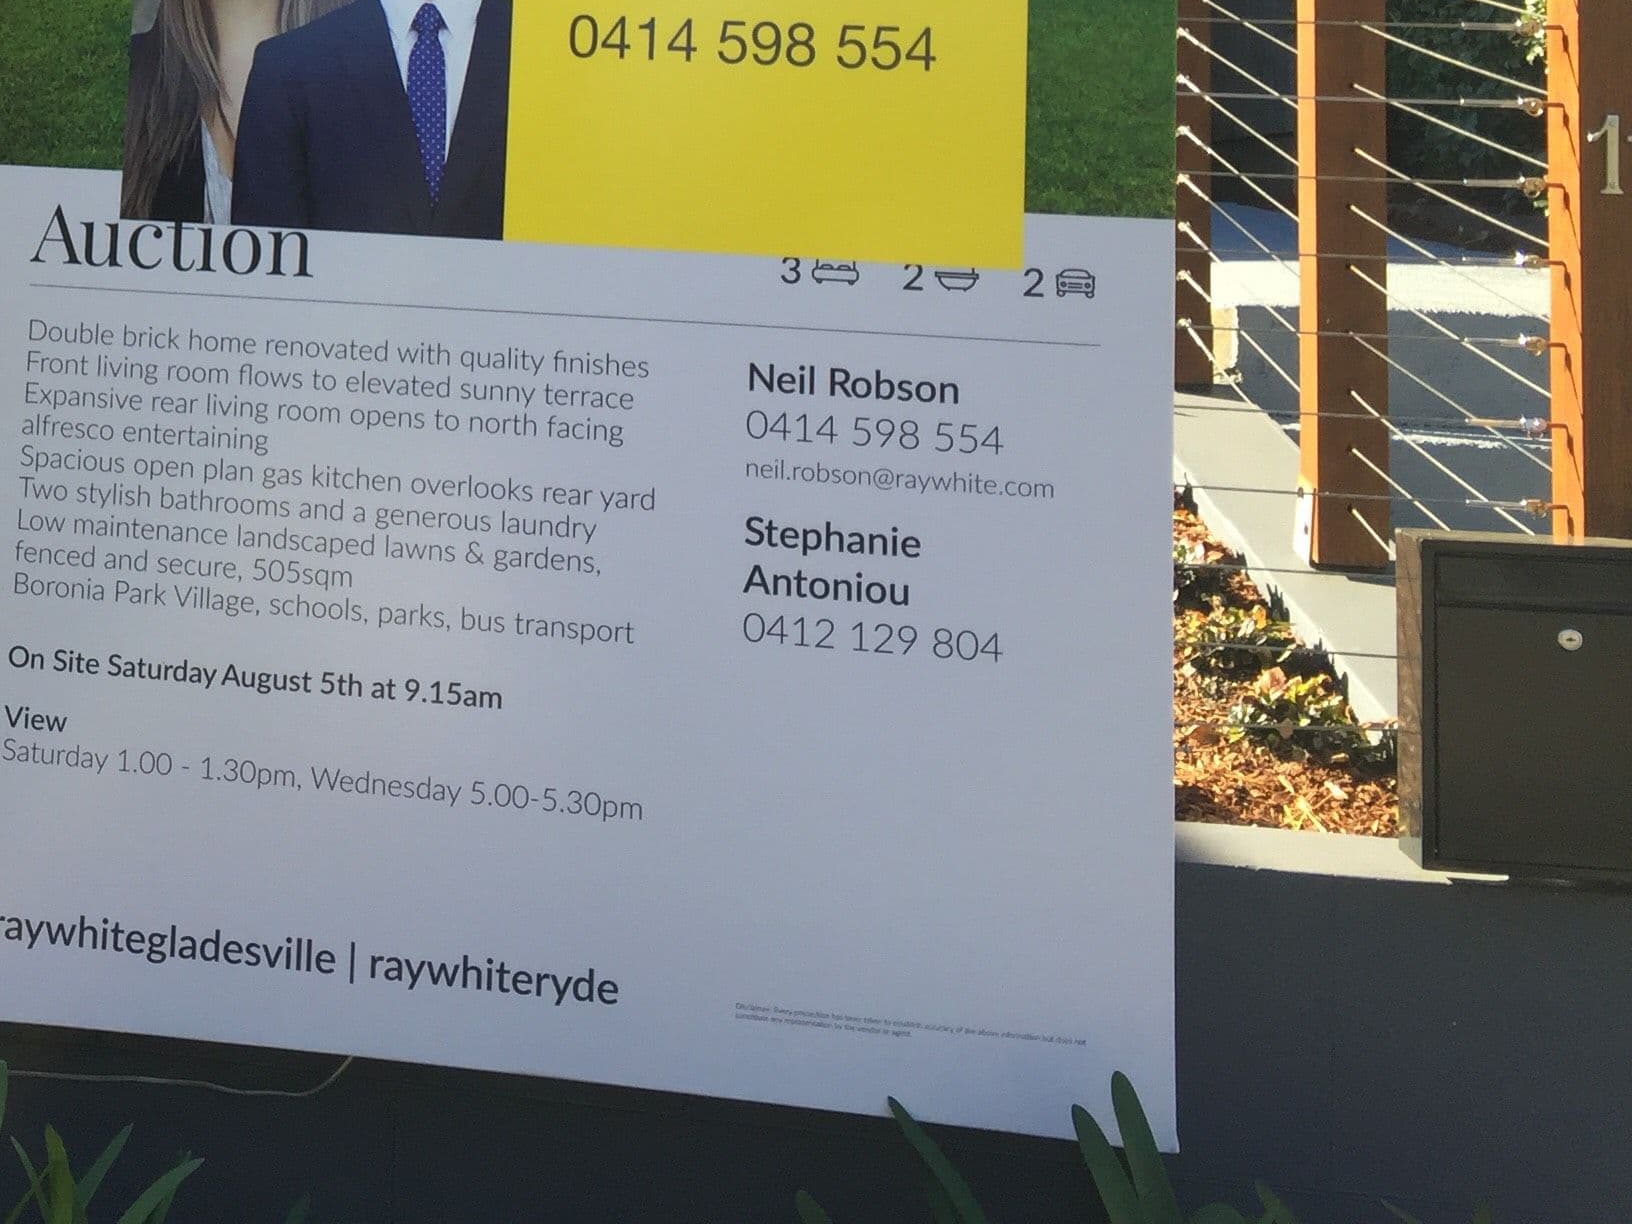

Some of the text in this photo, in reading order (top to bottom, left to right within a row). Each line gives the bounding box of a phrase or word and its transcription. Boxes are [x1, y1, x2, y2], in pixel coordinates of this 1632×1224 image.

[570, 15, 936, 71] 0414 598 554
[29, 203, 314, 278] Auction
[780, 257, 1045, 298] 3 2 2
[29, 319, 649, 378] Double brick home renovated with quality finishes
[27, 351, 633, 409] Front living room flows to elevated sunny terrace
[750, 363, 958, 404] Neil Robson
[22, 414, 268, 456] alfresco entertaining
[25, 382, 623, 447] Expansive rear living room opens to north facing
[747, 410, 1003, 454] 0414 598 554
[21, 445, 655, 512] Spacious open plan gas kitchen overlooks rear yard
[747, 460, 1053, 498] neil.robson@raywhite.com
[19, 476, 596, 544] Two stylish bathrooms and a generous laundry
[18, 509, 600, 576] Low maintenance landscaped lawns & gardens,
[745, 516, 920, 558] Stephanie
[16, 540, 352, 591] fenced and secure, 505sqm
[743, 565, 908, 606] Antoniou
[15, 572, 634, 645] Boronia Park Village, schools, parks, bus transport
[744, 613, 1002, 662] 0412 129 804
[9, 646, 502, 710] On Site Saturday August 5th at 9.15am
[5, 705, 67, 732] View
[3, 738, 108, 774] Saturday
[119, 749, 172, 775] 1.00
[202, 757, 301, 791] 1.30pm,
[311, 767, 461, 807] Wednesday
[471, 781, 642, 822] 5.00-5.30pm
[371, 955, 618, 1006] raywhiteryde
